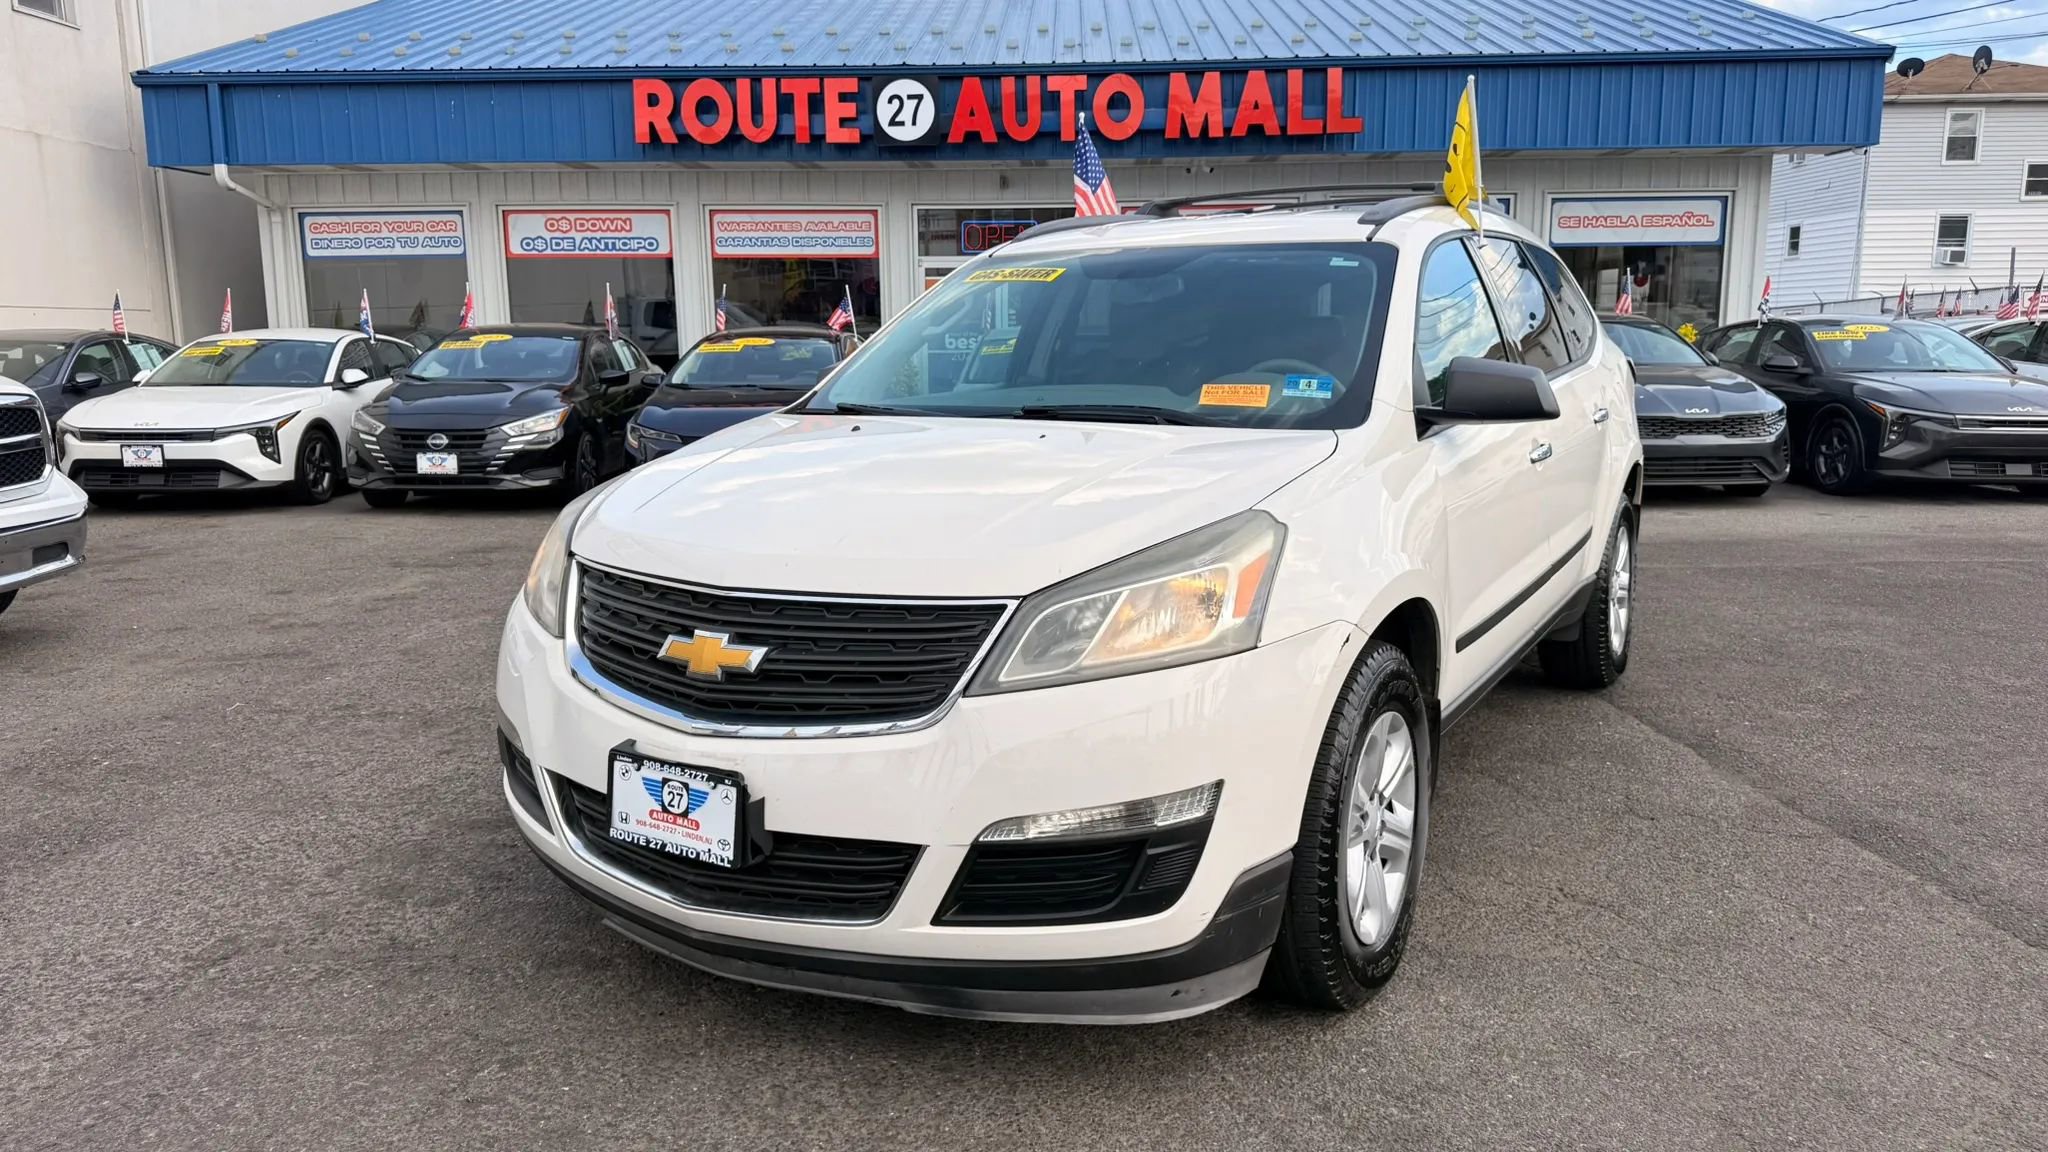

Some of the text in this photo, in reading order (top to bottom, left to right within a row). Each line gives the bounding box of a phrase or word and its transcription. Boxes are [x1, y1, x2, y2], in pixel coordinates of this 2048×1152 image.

[632, 67, 1363, 145] ROUTE 27 AUTO MALL
[309, 220, 458, 234] CASH FOR YOUR CAR
[575, 217, 632, 233] DOWN
[717, 219, 872, 233] WARRANTIES AVAILABLE
[1558, 211, 1715, 228] SE HABLA ESPAÑOL
[310, 236, 462, 249] DINERO POR TU AUTO
[549, 236, 578, 252] DE
[579, 235, 660, 252] ANTICIPO
[716, 235, 873, 249] GARANTIAS DISPONIBLES
[964, 223, 1025, 250] OPE
[643, 759, 709, 782] 908-648-2727
[667, 783, 684, 793] ROUTE
[667, 790, 684, 811] 27
[635, 818, 677, 836] 908-648-2727
[652, 811, 698, 830] AUTO MALL
[609, 828, 732, 868] ROUTE 27 AUTO MALL
